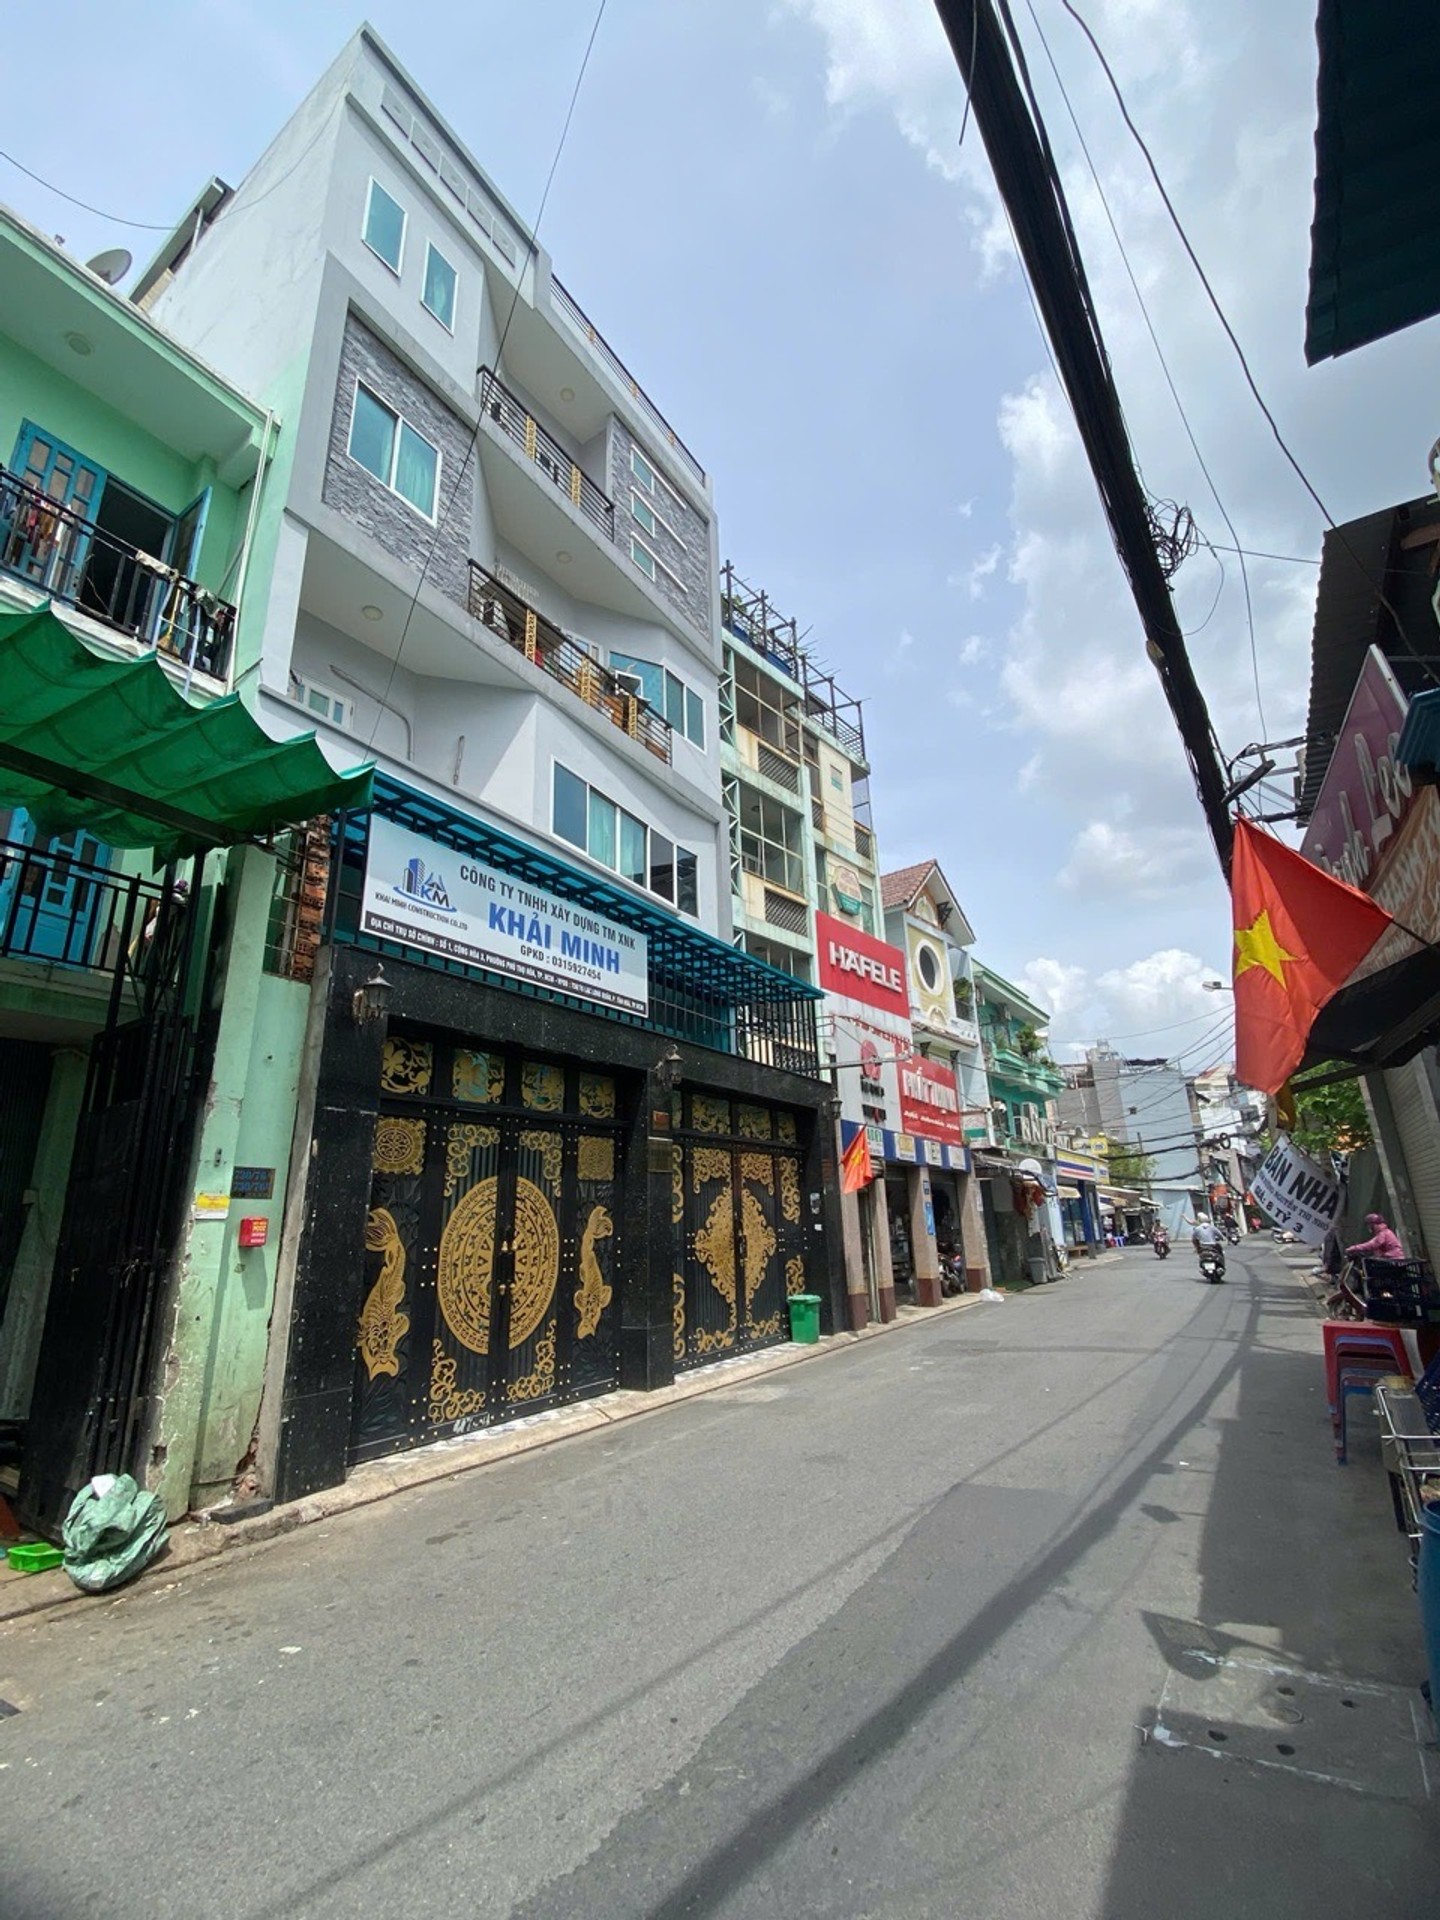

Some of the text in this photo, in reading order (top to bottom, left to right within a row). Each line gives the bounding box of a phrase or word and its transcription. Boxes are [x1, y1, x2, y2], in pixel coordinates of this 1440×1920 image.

[460, 863, 636, 950] CÔNG TY TNHH XÂY DỰNG TM XNK
[488, 901, 620, 974] KHẢI MINH
[520, 944, 544, 962] GPKD
[1264, 1145, 1293, 1187] BÁN
[1293, 1222, 1304, 1233] 3
